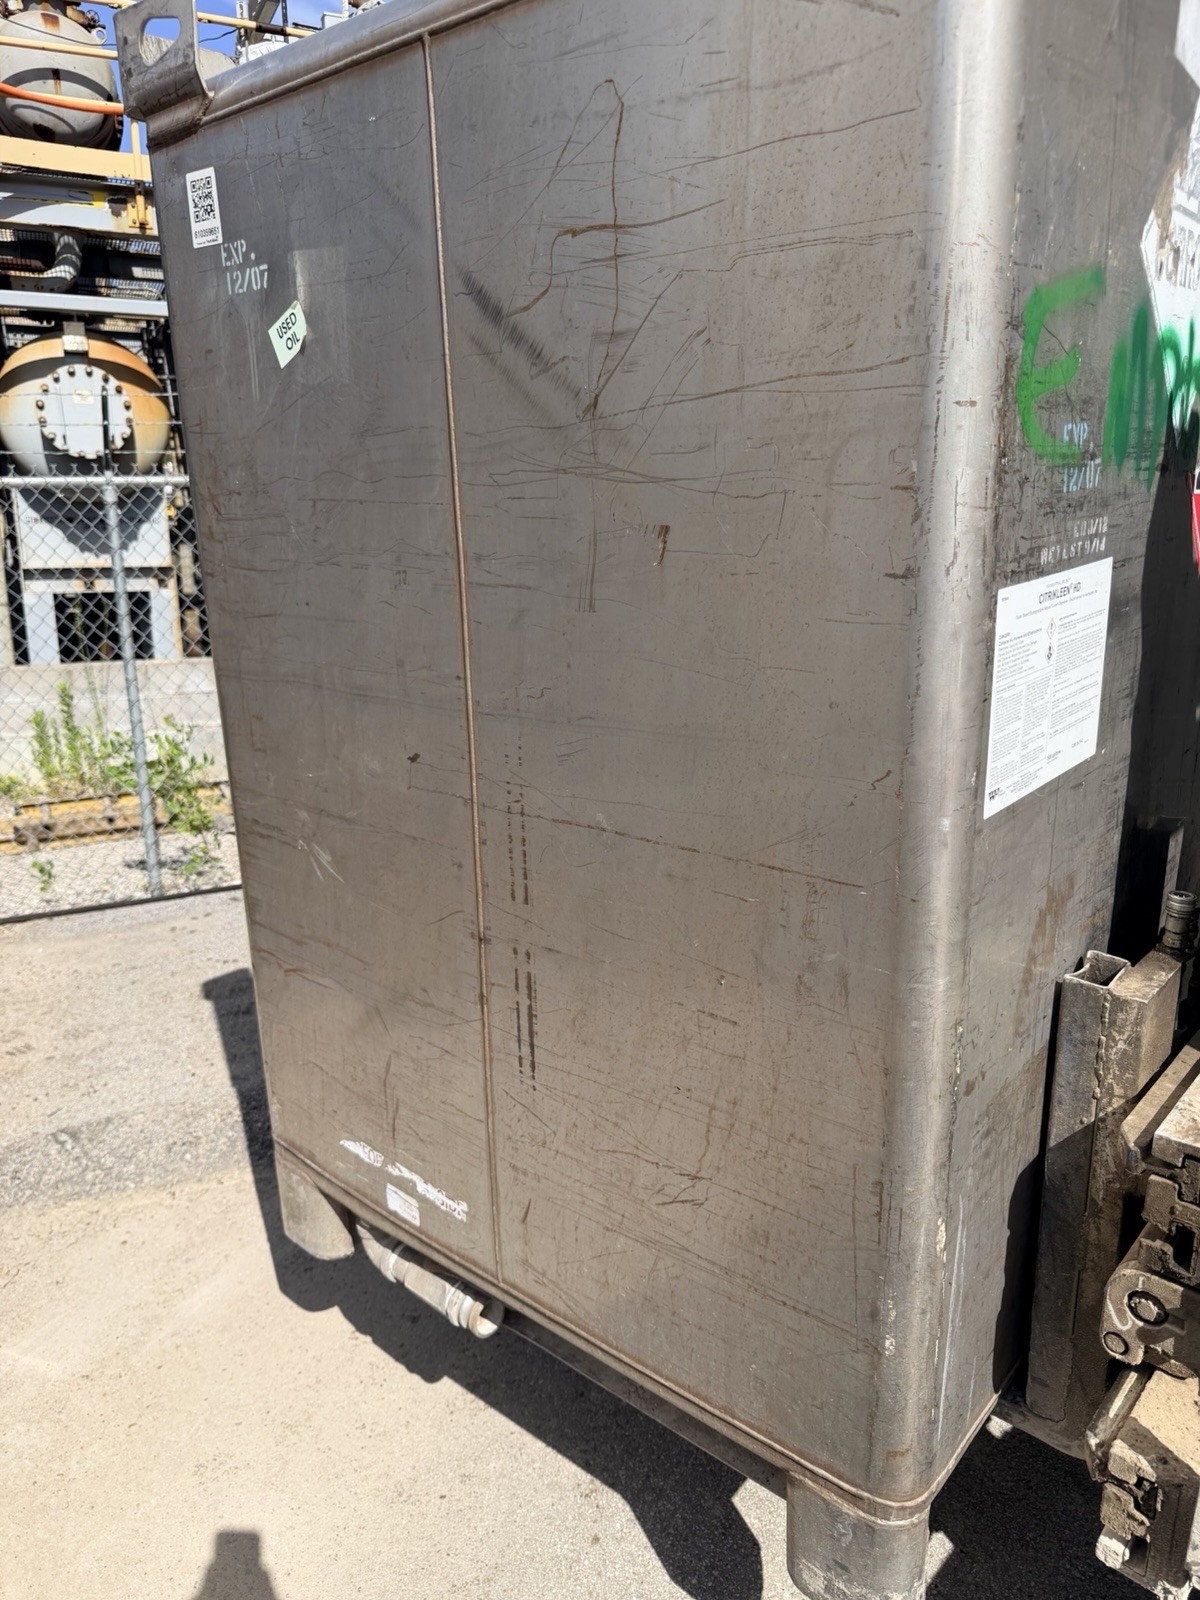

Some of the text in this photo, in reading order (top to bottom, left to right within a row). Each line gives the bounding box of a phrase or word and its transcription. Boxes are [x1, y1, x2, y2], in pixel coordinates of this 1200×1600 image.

[220, 239, 256, 267] EXP.
[226, 264, 269, 295] 12/07
[276, 312, 297, 340] USED
[285, 329, 301, 351] OIL
